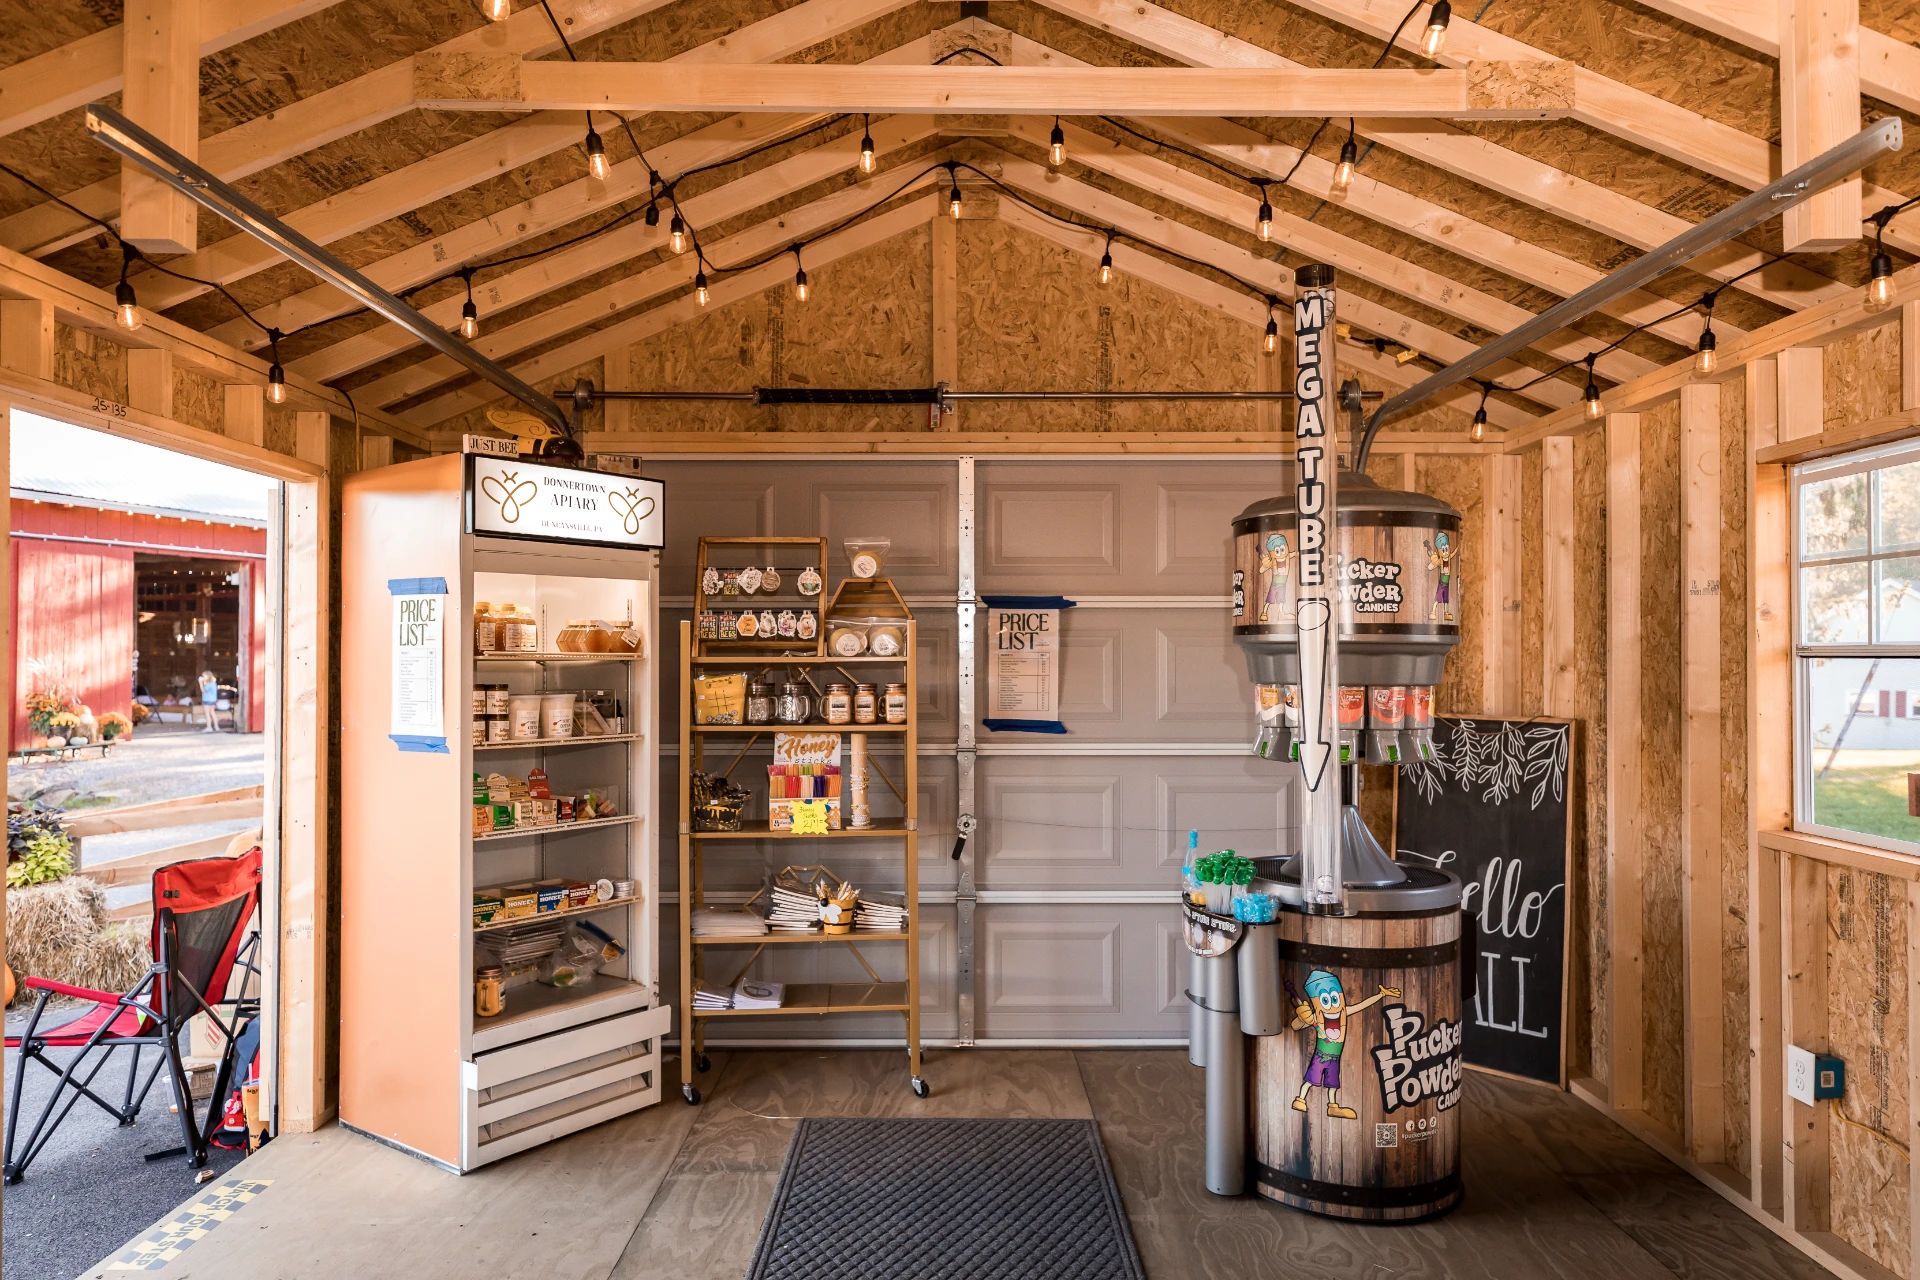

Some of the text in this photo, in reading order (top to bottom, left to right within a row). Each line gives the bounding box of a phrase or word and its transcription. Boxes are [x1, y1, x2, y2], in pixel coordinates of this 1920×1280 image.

[470, 438, 518, 455] JUST BEE
[1295, 296, 1324, 585] MEGA TUBE
[543, 476, 606, 494] DONNERTOWN
[550, 493, 599, 511] APIARY
[400, 598, 437, 623] PRICE
[1356, 603, 1399, 613] CANDIES
[999, 613, 1050, 632] PRICE
[399, 623, 429, 646] LIST
[998, 632, 1039, 650] LIST
[776, 737, 838, 762] Honey
[136, 1182, 256, 1266] WATCH YOUR STEP
